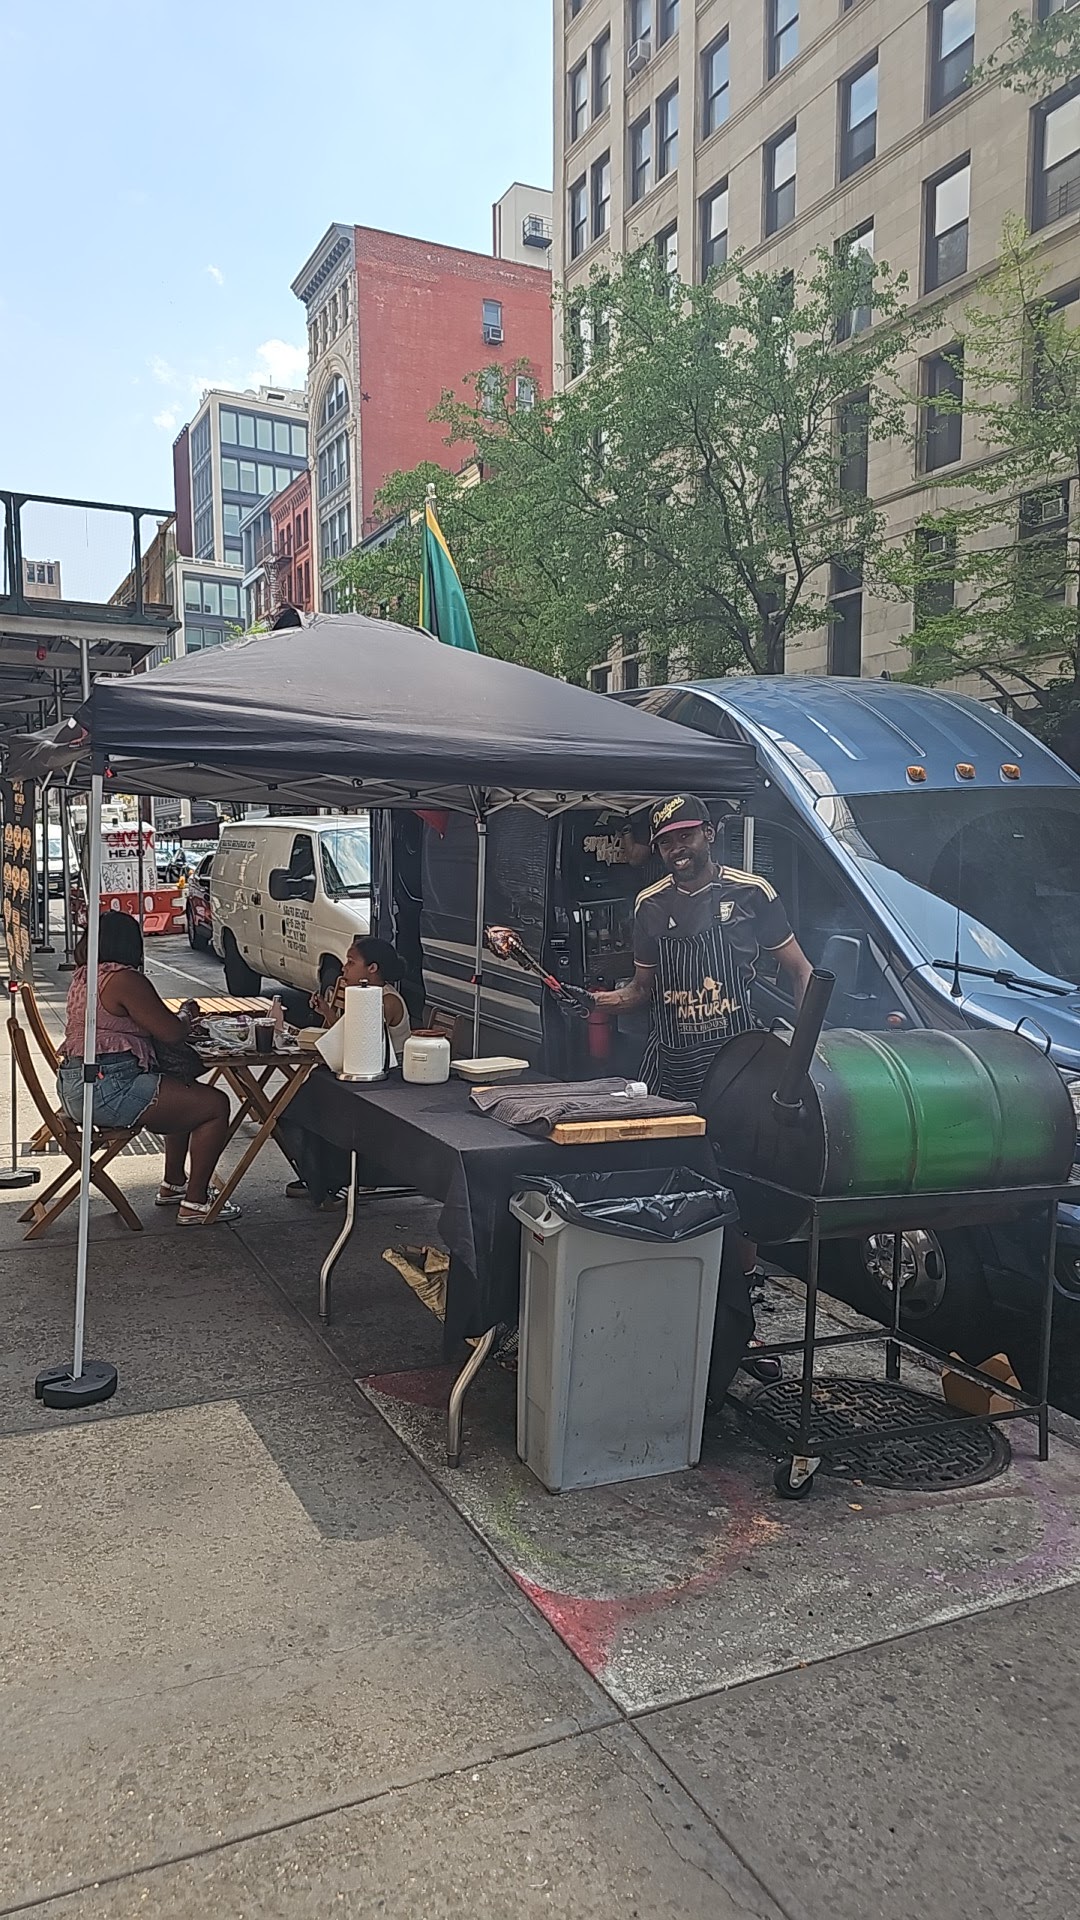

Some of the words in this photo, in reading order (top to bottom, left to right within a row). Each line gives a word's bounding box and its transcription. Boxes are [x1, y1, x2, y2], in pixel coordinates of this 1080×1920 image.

[653, 796, 685, 828] Dodgers
[109, 849, 145, 858] HEAD
[664, 988, 706, 1005] SIMPLY
[679, 998, 741, 1020] NATURAL
